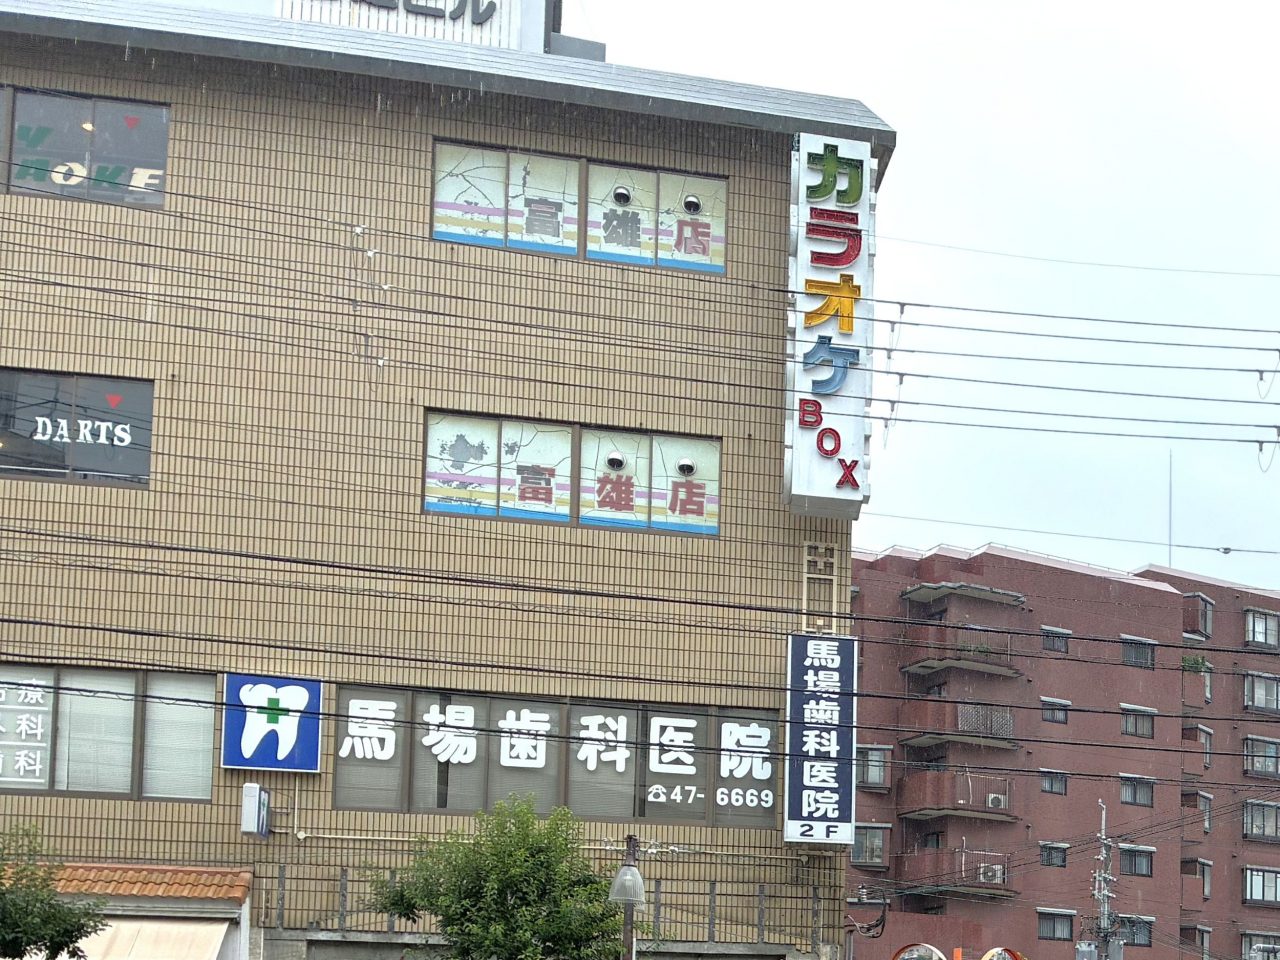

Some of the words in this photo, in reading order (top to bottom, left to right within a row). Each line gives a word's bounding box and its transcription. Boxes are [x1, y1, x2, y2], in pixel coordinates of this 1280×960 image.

[803, 143, 864, 395] カラオケ
[32, 416, 132, 447] DARTS
[799, 398, 860, 490] BOX
[516, 464, 706, 517] 富雄店
[339, 699, 772, 780] 馬場歯科医院
[802, 640, 841, 819] 馬場歯科医院
